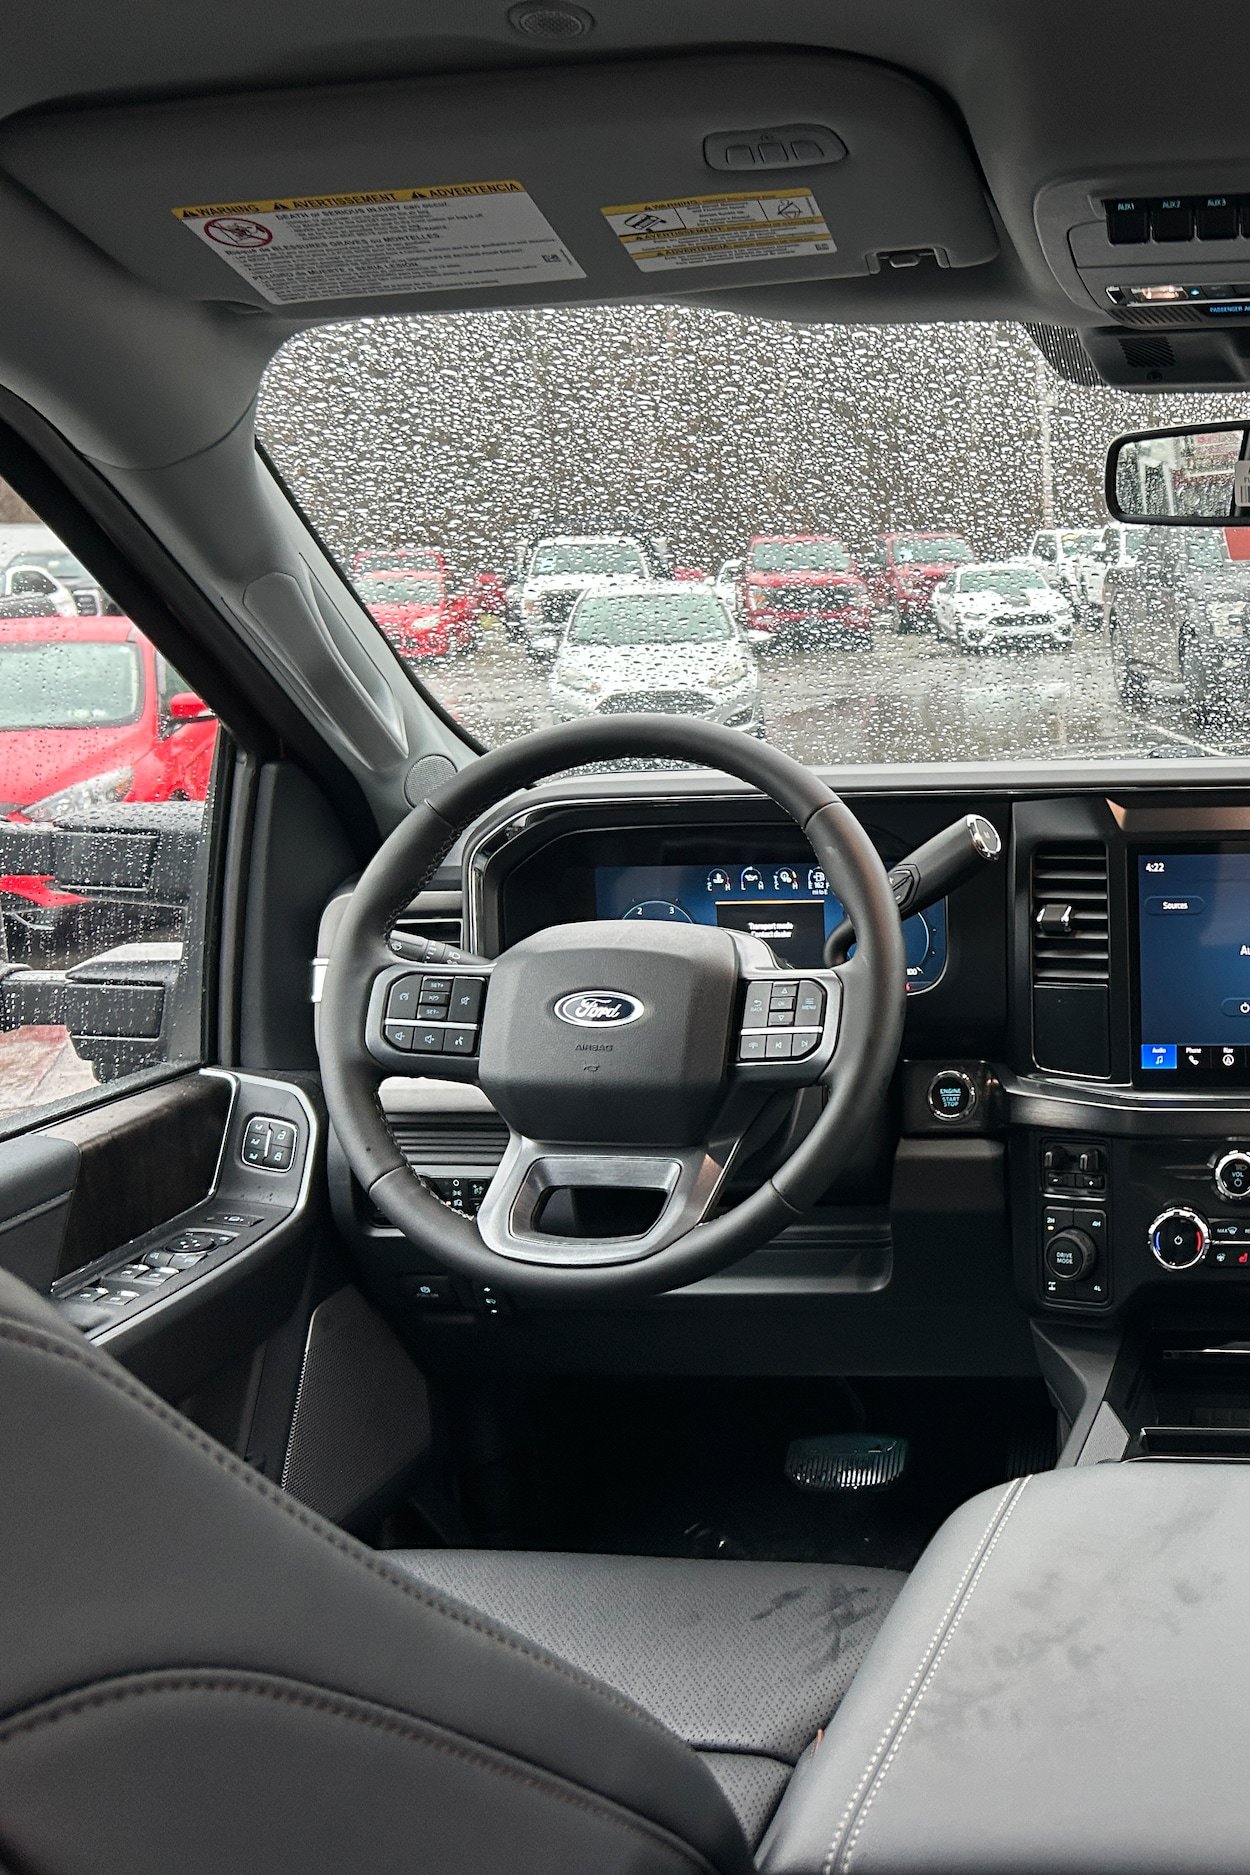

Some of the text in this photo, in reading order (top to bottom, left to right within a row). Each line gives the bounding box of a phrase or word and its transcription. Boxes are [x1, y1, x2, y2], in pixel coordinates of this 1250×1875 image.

[429, 183, 519, 197] ADVERTENCIA
[292, 193, 397, 209] AVERTISSEMENT
[651, 200, 698, 209] WARNING
[196, 205, 260, 217] WARNING
[664, 244, 729, 255] ADVERTENCIA
[1145, 862, 1165, 873] 4:22
[1162, 901, 1189, 910] Sources
[748, 922, 794, 931] Transport mode
[774, 930, 793, 938] dealer
[574, 998, 622, 1018] Ford
[574, 1044, 614, 1052] AIRBAG
